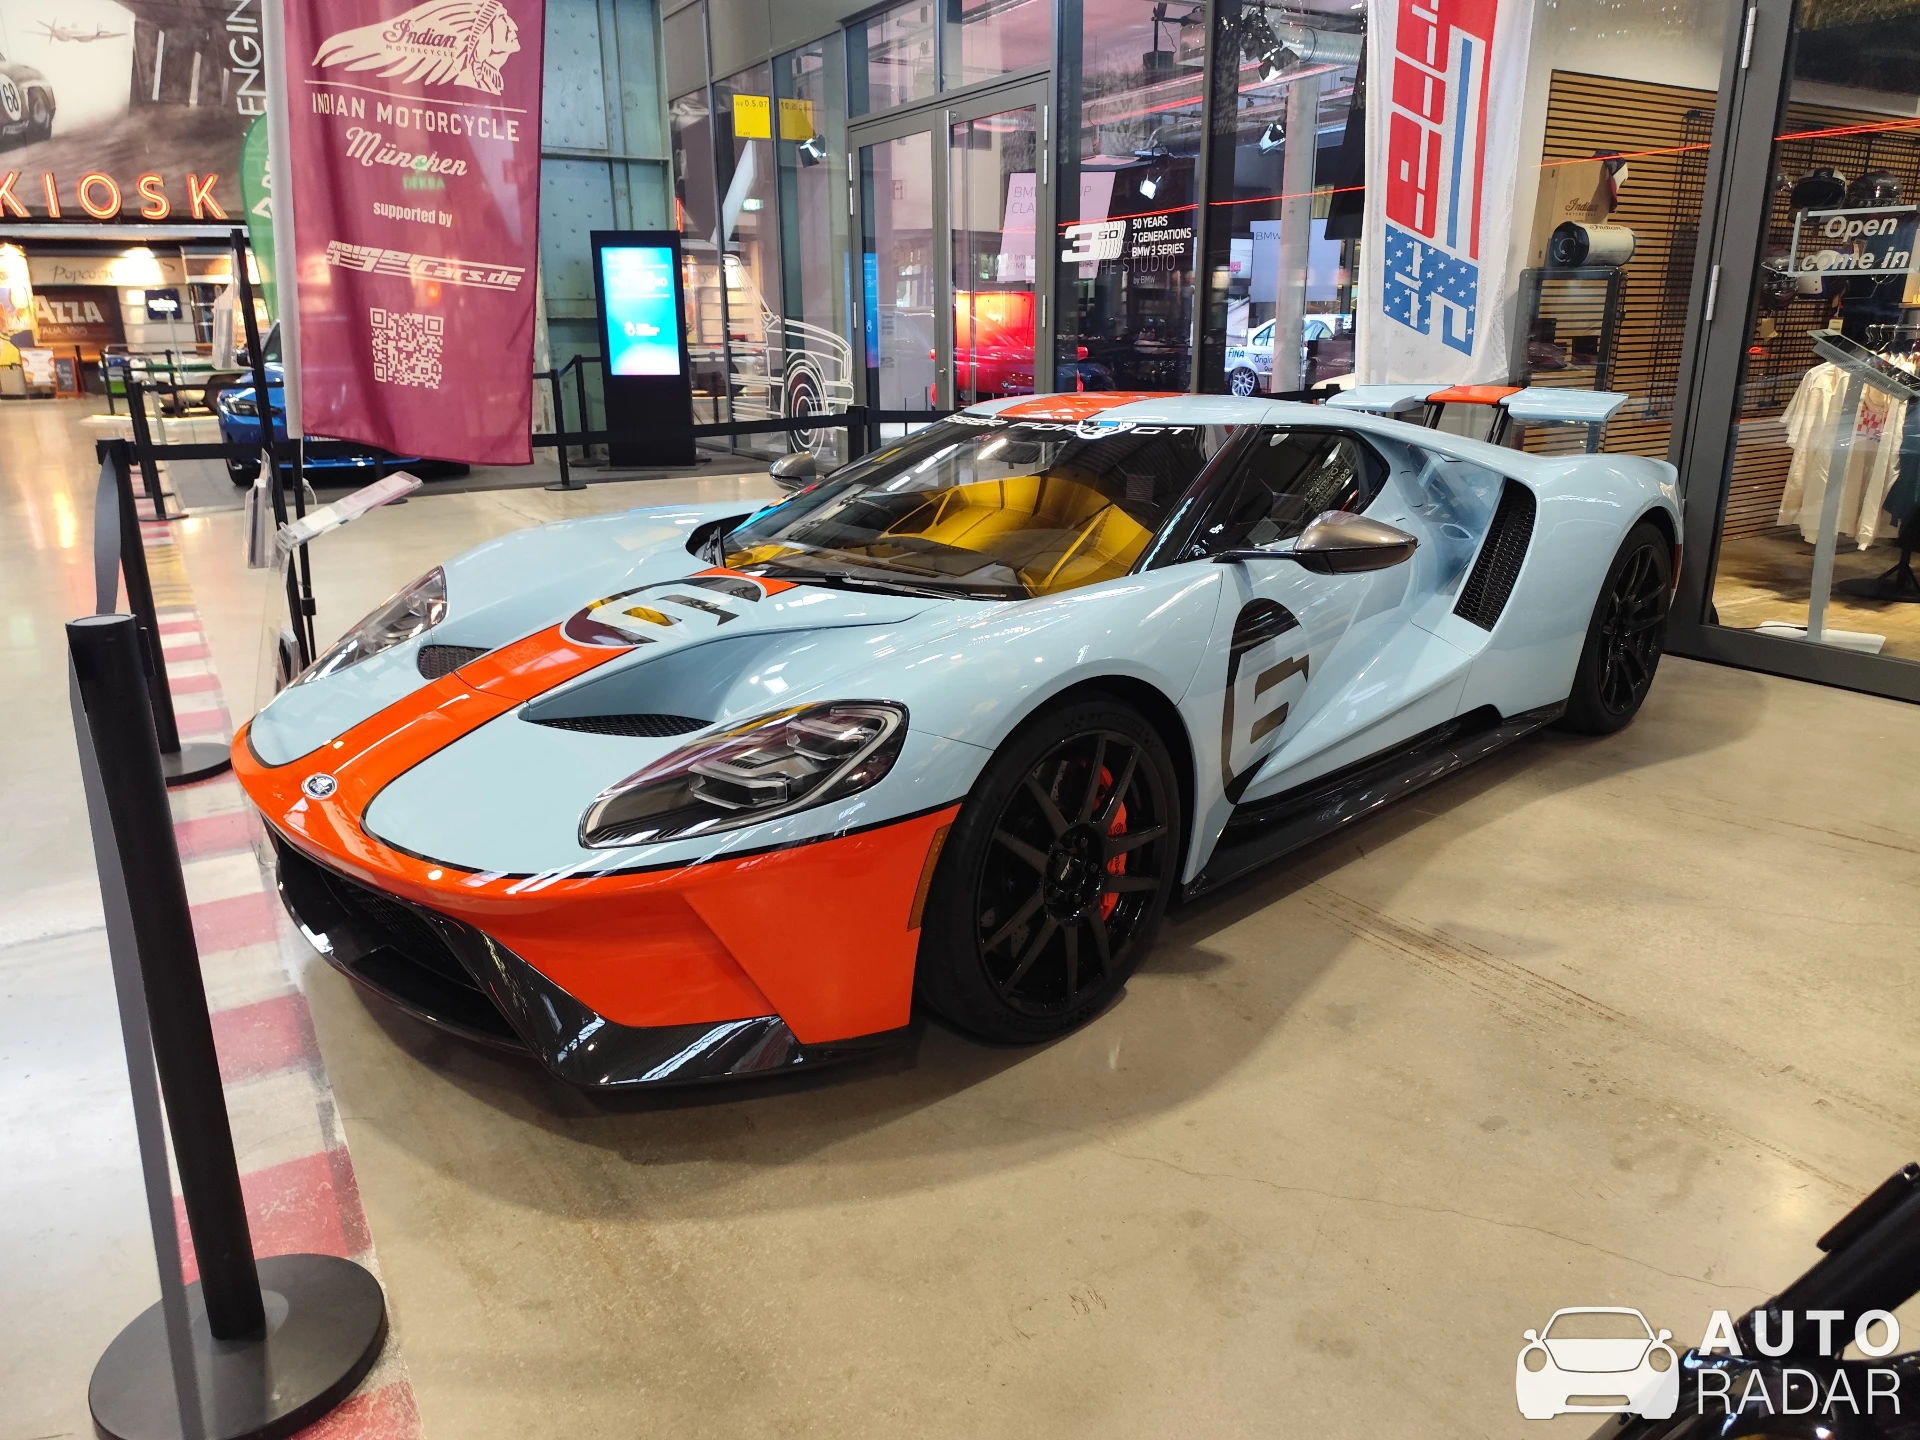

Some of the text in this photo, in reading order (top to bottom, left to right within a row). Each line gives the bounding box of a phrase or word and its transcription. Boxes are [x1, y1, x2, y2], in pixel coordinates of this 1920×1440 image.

[382, 19, 457, 49] Indian
[385, 44, 455, 58] MOTORCYCLE
[2, 82, 20, 113] 68
[312, 92, 521, 142] INDIAN MOTORCYCLE
[346, 127, 468, 176] München
[0, 170, 229, 220] KIOSK
[1014, 186, 1036, 198] BM
[1564, 197, 1599, 212] Indian
[373, 202, 453, 227] supported by
[1132, 215, 1168, 229] 50 YEARS
[1097, 229, 1119, 240] 50
[1132, 228, 1192, 243] 7 GENERATIONS
[1824, 216, 1898, 243] Open
[1132, 245, 1150, 257] BMW
[1151, 245, 1157, 256] 3
[1157, 243, 1185, 256] SERIES
[1100, 259, 1117, 275] HE
[1122, 254, 1176, 275] STUDIO
[1801, 246, 1910, 271] come in
[1140, 275, 1155, 284] BMW
[1228, 347, 1245, 358] FINA
[1129, 426, 1196, 435] GT
